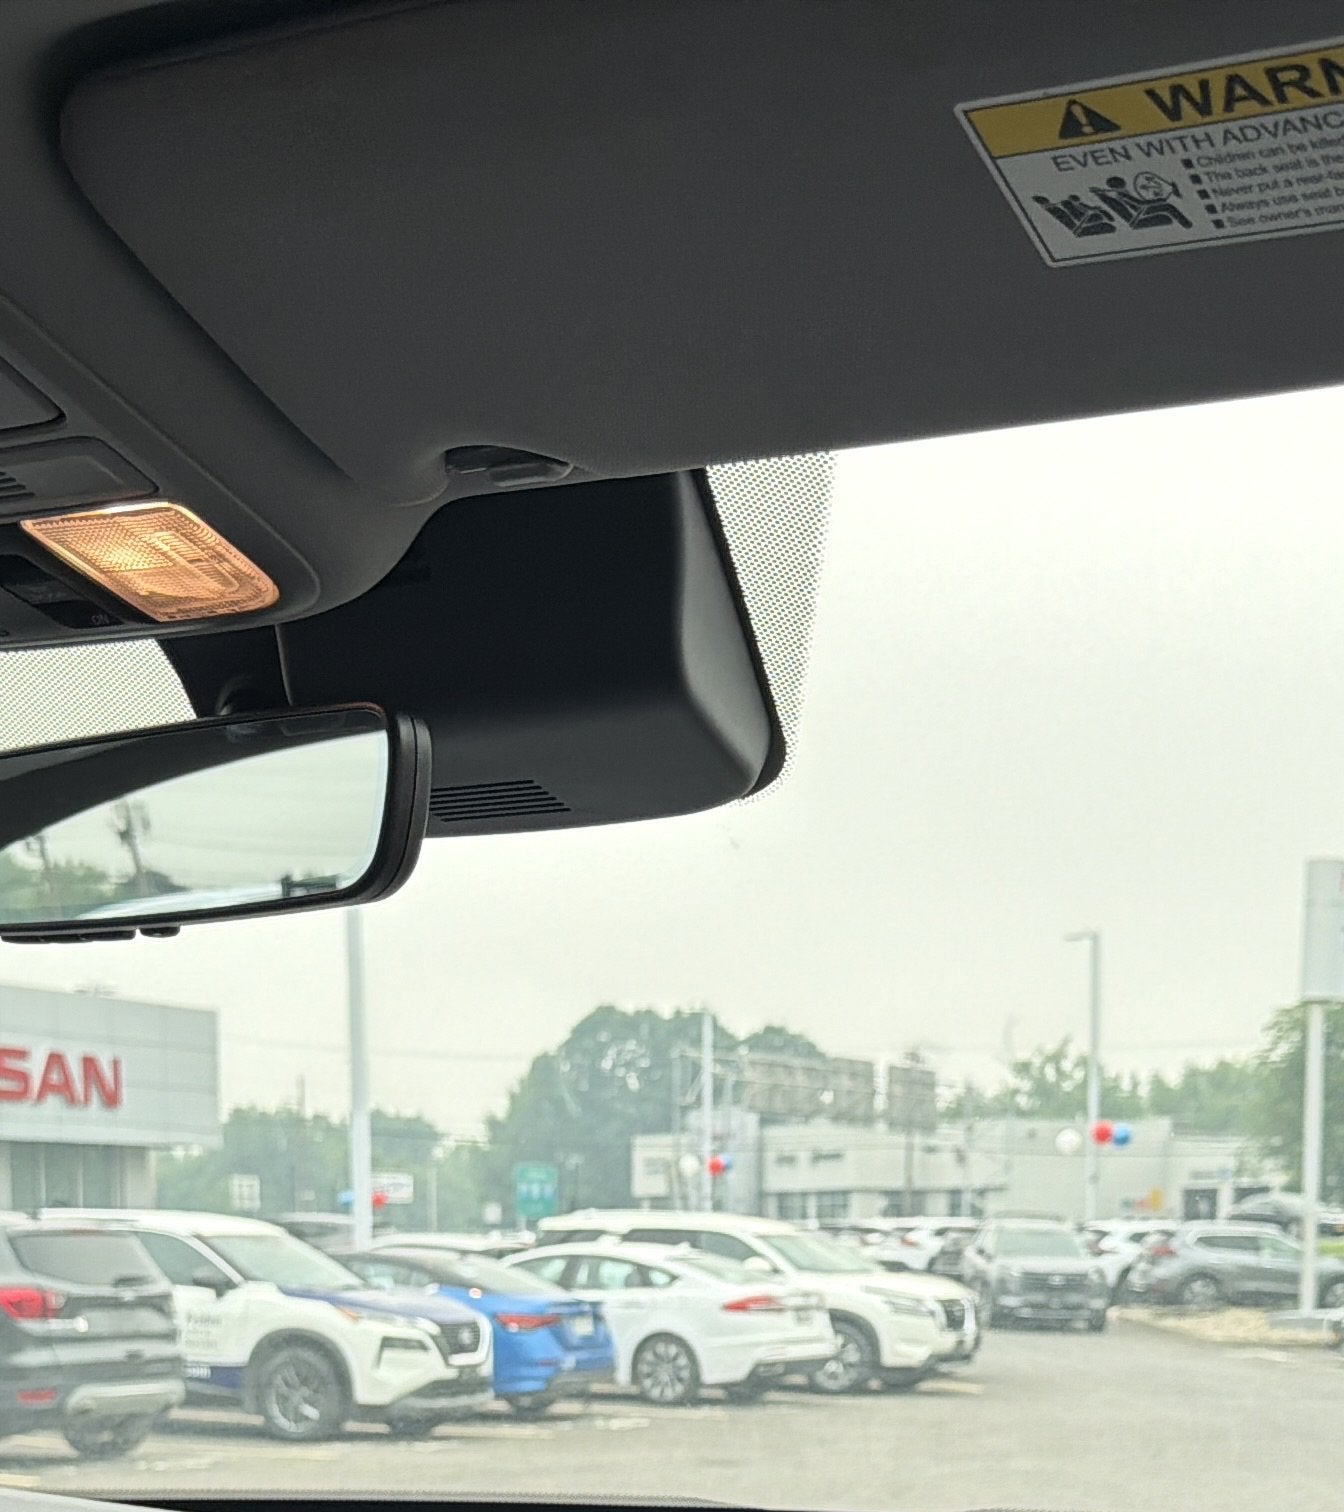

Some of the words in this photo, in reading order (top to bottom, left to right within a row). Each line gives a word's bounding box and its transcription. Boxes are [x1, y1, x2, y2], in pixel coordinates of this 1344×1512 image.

[1049, 144, 1133, 172] EVEN
[1135, 132, 1216, 159] WITH
[1194, 148, 1255, 166] Children
[1257, 147, 1282, 157] can
[1282, 141, 1307, 153] be
[1205, 169, 1233, 181] The
[1233, 164, 1268, 177] back
[1270, 159, 1302, 172] seat
[1304, 156, 1320, 167] is
[1320, 153, 1344, 165] the
[1211, 183, 1253, 197] Never
[1255, 179, 1281, 192] put
[1282, 179, 1294, 187] a
[1219, 197, 1270, 213] Always
[1272, 194, 1298, 205] use
[1227, 215, 1255, 226] See
